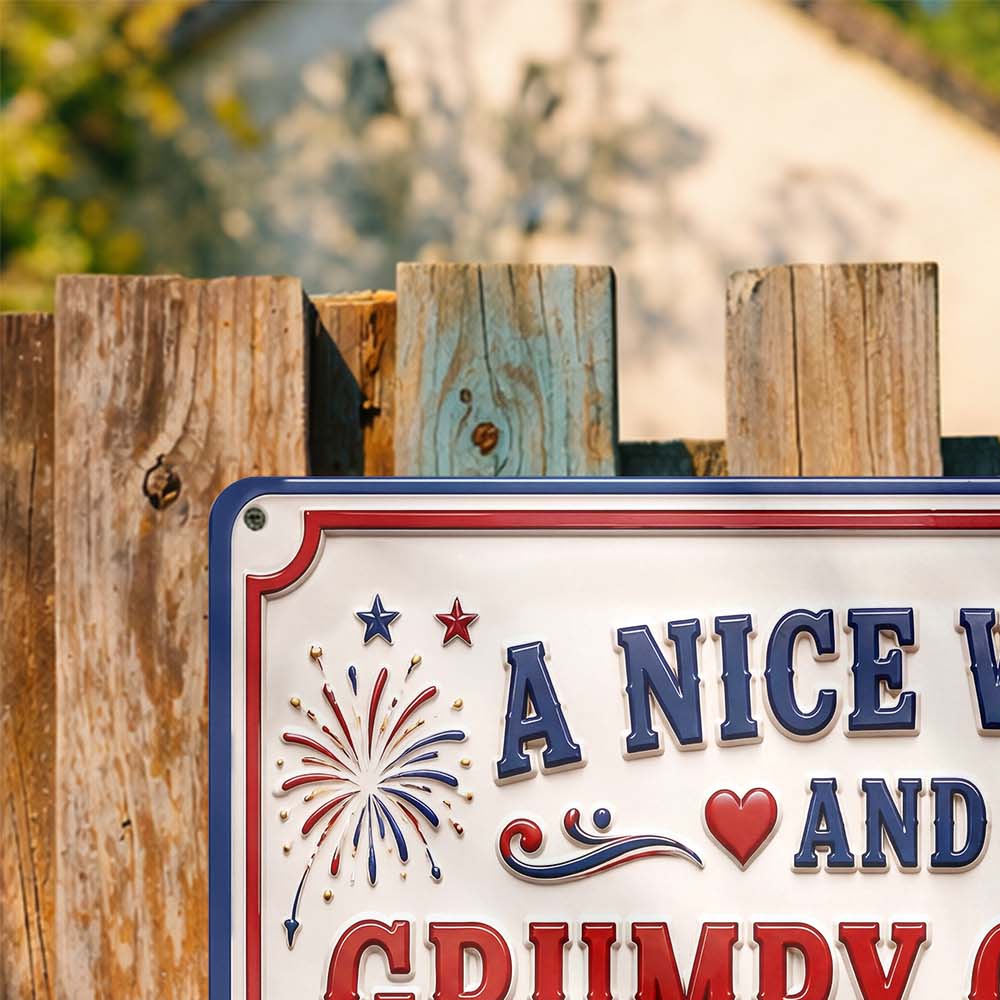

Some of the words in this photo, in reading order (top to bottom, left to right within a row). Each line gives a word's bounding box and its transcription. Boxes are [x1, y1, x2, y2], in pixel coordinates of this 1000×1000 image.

[496, 641, 582, 778] A
[616, 607, 916, 758] NICE
[793, 778, 988, 868] AND
